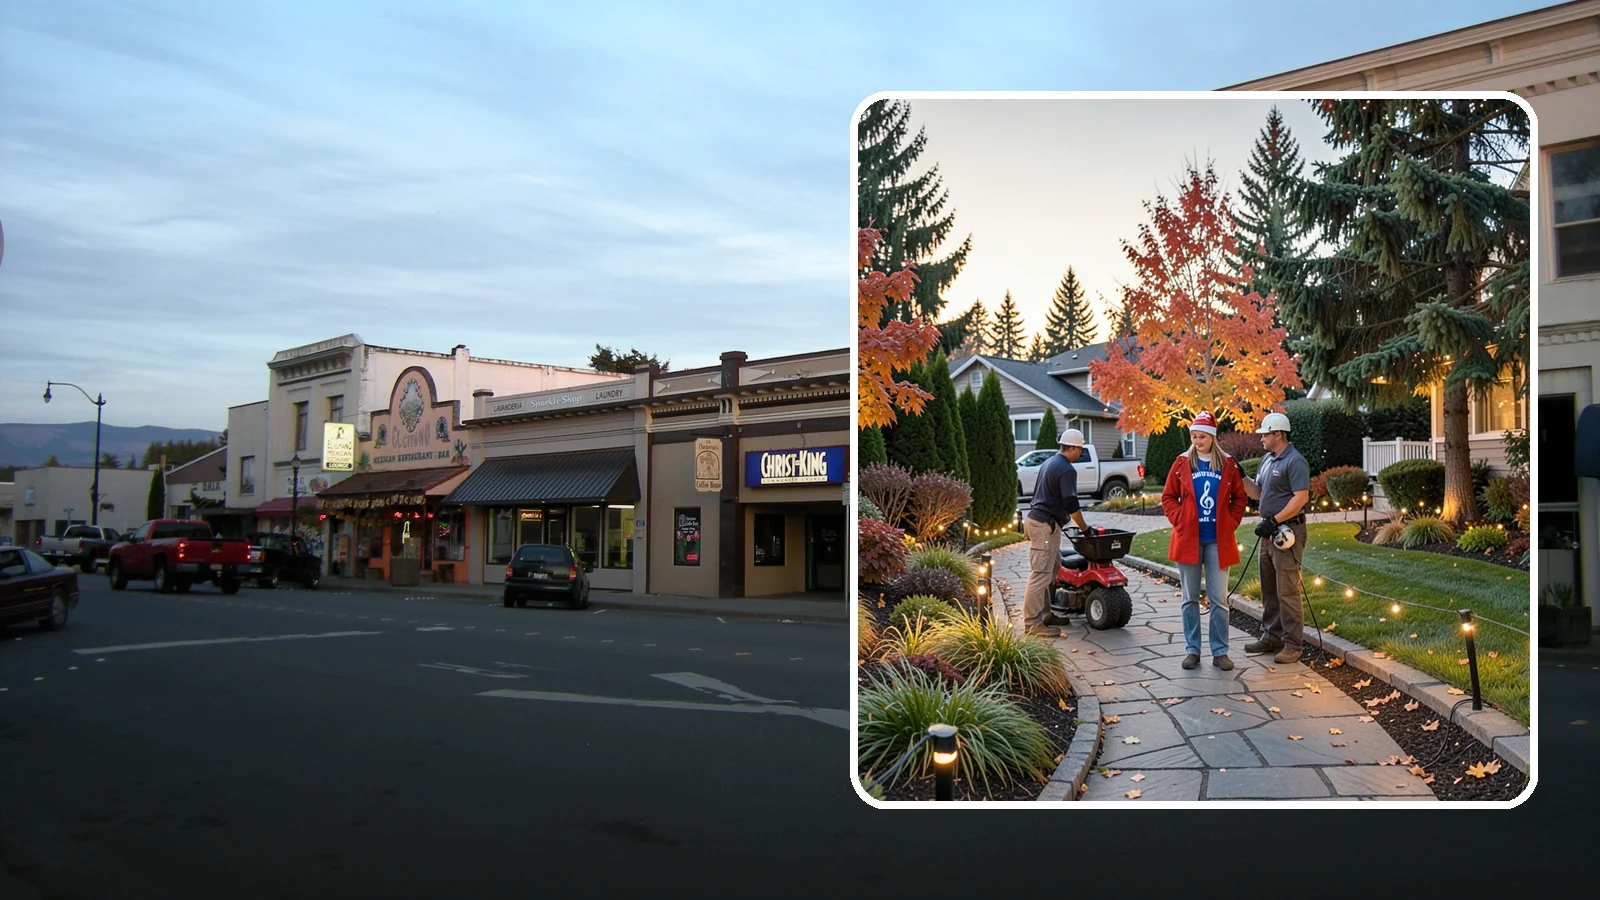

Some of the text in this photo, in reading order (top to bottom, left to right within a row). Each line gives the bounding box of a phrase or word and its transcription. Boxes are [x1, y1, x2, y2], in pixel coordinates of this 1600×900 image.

[493, 389, 624, 412] LAVANDERIA Sparkle Shop LAUNDRY
[373, 454, 396, 464] MEXICAN
[398, 451, 433, 462] RESTAURANT
[438, 450, 450, 459] BAR
[799, 450, 827, 476] KING
